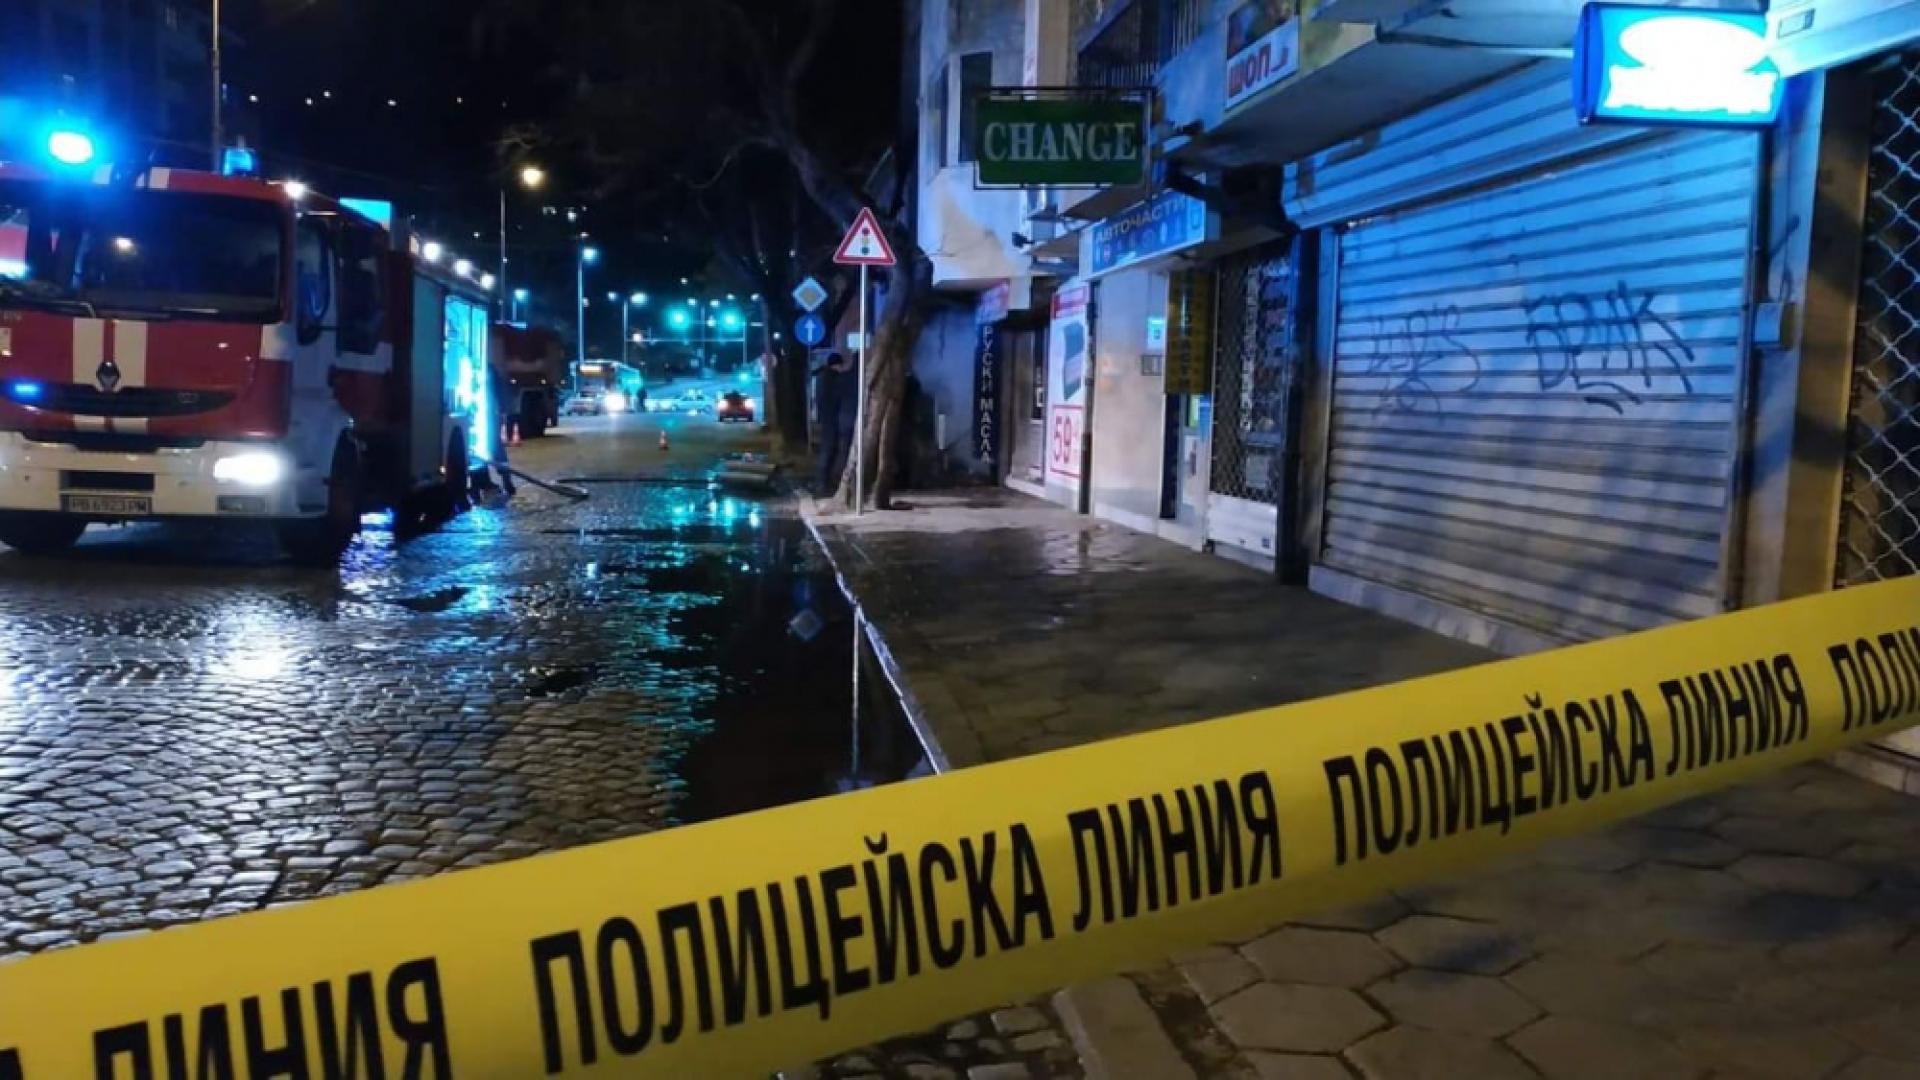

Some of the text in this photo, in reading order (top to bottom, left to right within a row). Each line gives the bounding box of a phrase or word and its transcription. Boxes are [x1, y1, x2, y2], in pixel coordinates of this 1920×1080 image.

[984, 121, 1138, 162] CHANGE
[529, 823, 1055, 1075] ПОЛИЦЕЙСКА
[1067, 770, 1283, 931] ЛИНИЯ
[1323, 688, 1655, 865] ПОЛИЦЕЙСКА
[1658, 653, 1809, 777] ЛИНИЯ
